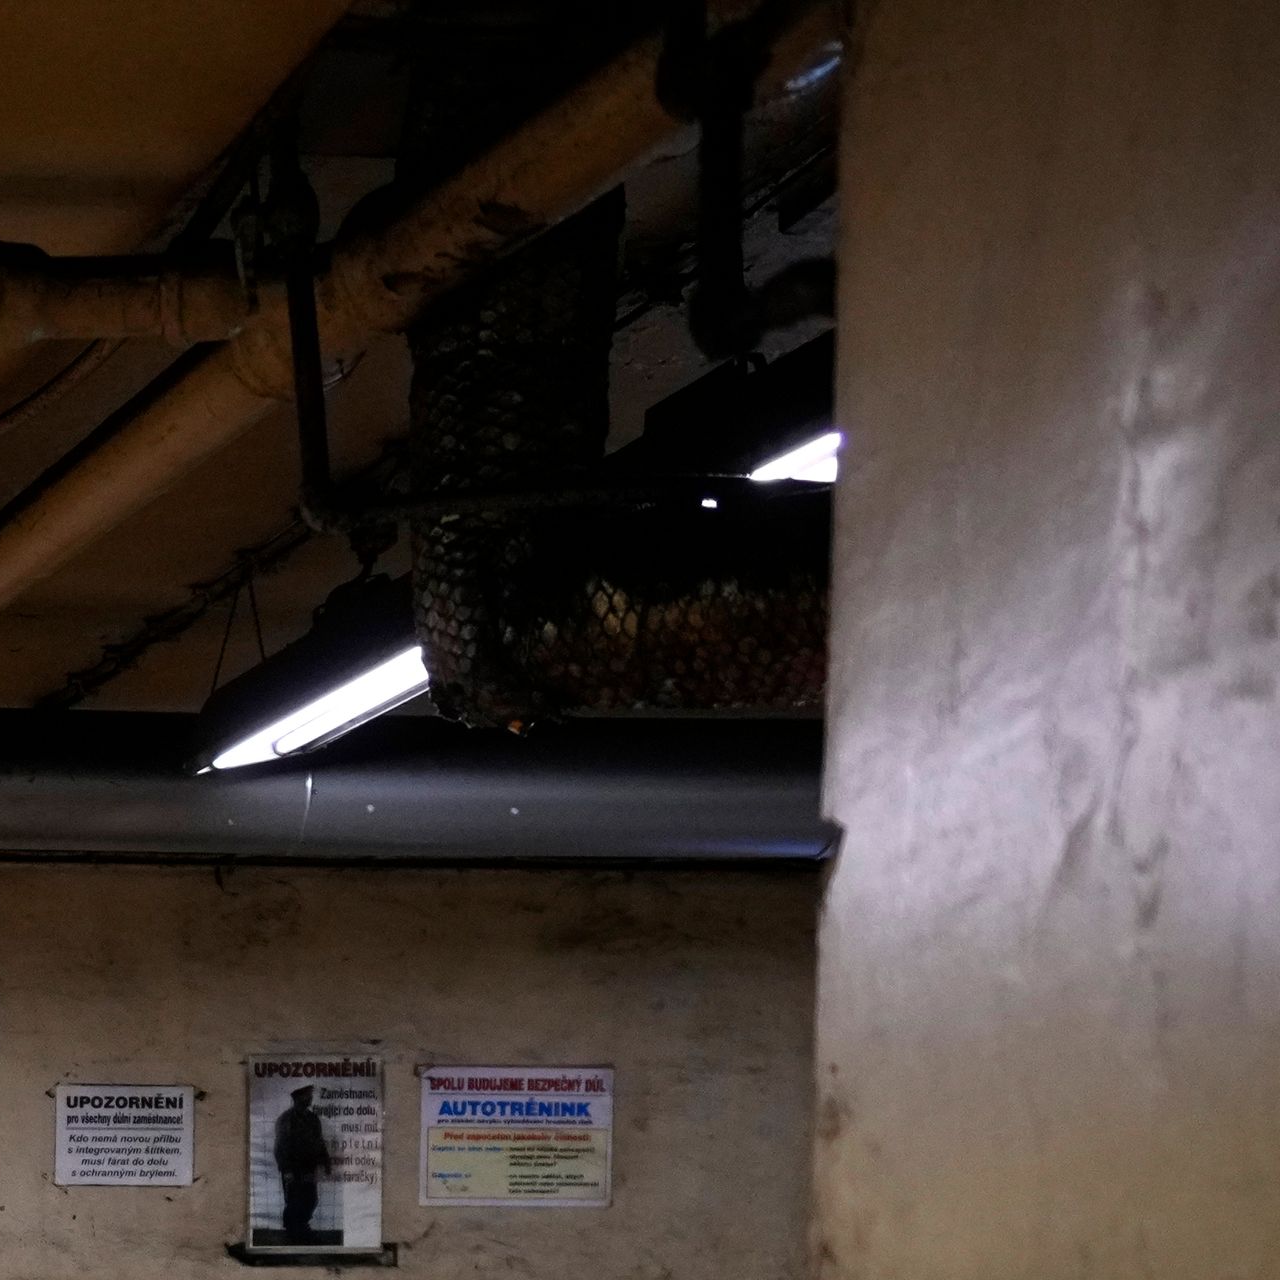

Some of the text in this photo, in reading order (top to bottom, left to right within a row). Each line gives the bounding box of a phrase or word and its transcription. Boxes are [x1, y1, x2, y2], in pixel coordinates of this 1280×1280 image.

[430, 1077, 464, 1091] SPOLU
[66, 1093, 184, 1109] UPOZORNĚNÍ
[439, 1097, 592, 1117] AUTOTRÉNINK
[66, 1115, 79, 1126] pro
[81, 1112, 111, 1126] všechny
[69, 1134, 89, 1143] Kdo
[91, 1134, 118, 1143] nemá
[76, 1146, 142, 1156] integrovaným
[132, 1157, 145, 1165] do
[147, 1157, 169, 1165] dolu
[80, 1168, 137, 1179] ochrannými
